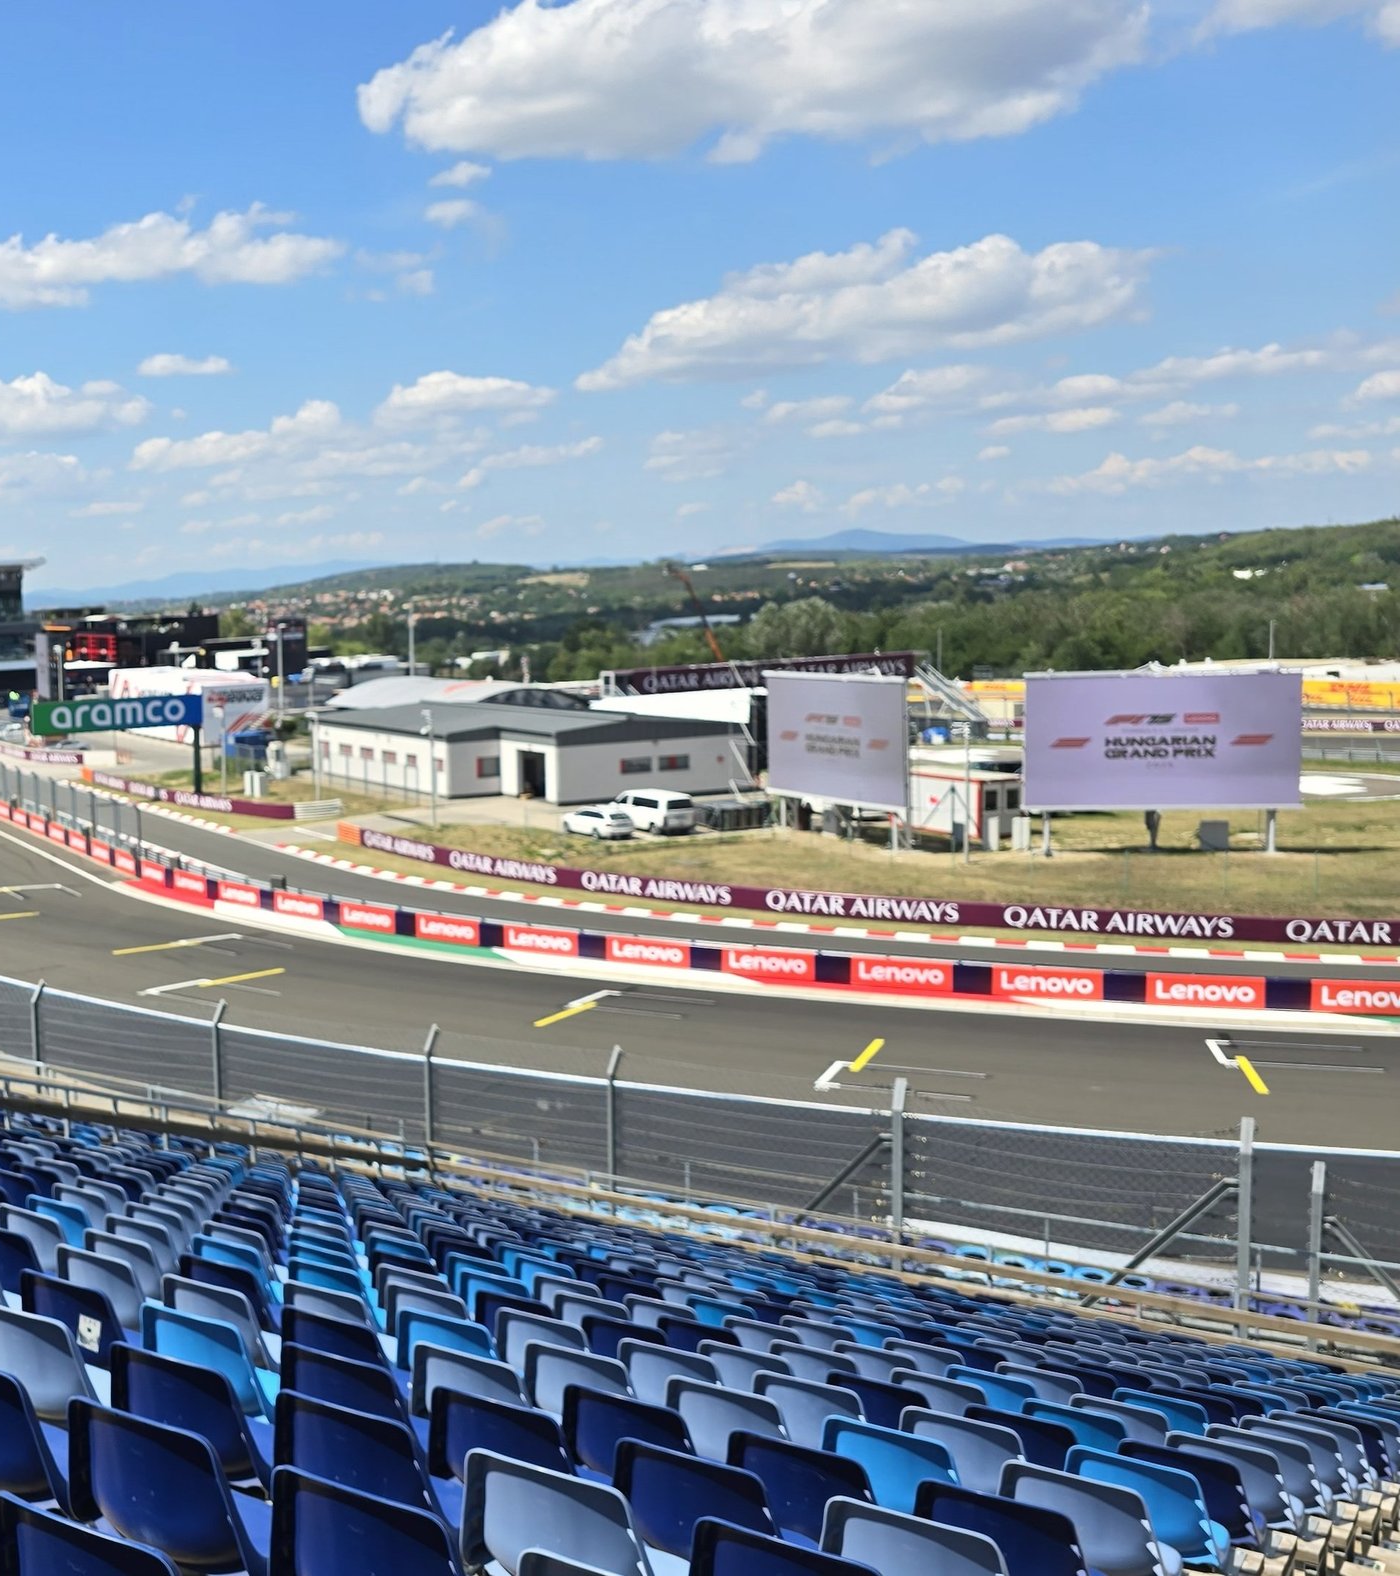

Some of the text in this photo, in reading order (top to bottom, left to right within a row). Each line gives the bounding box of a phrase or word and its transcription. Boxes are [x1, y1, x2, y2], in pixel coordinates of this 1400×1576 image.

[643, 672, 699, 693] QATAR
[51, 699, 186, 729] aramco
[1104, 735, 1216, 747] HUNGARIAN
[1104, 747, 1216, 759] GRAND PRIX
[449, 851, 558, 884] QATAR AIRWAYS
[580, 871, 732, 906] QATAR AIRWAYS
[343, 907, 392, 928] Lenovo
[765, 889, 959, 924] QATAR AIRWAYS
[420, 917, 475, 940] Lenovo
[1003, 906, 1234, 938] QATAR AIRWAYS
[1285, 919, 1391, 944] QATAR
[508, 928, 572, 951] Lenovo
[611, 940, 683, 962] Lenovo
[728, 950, 807, 974] Lenovo
[859, 961, 944, 985] Lenovo
[1000, 970, 1094, 995] Lenovo
[1155, 979, 1256, 1003] Lenovo
[1321, 985, 1400, 1009] Lenov
